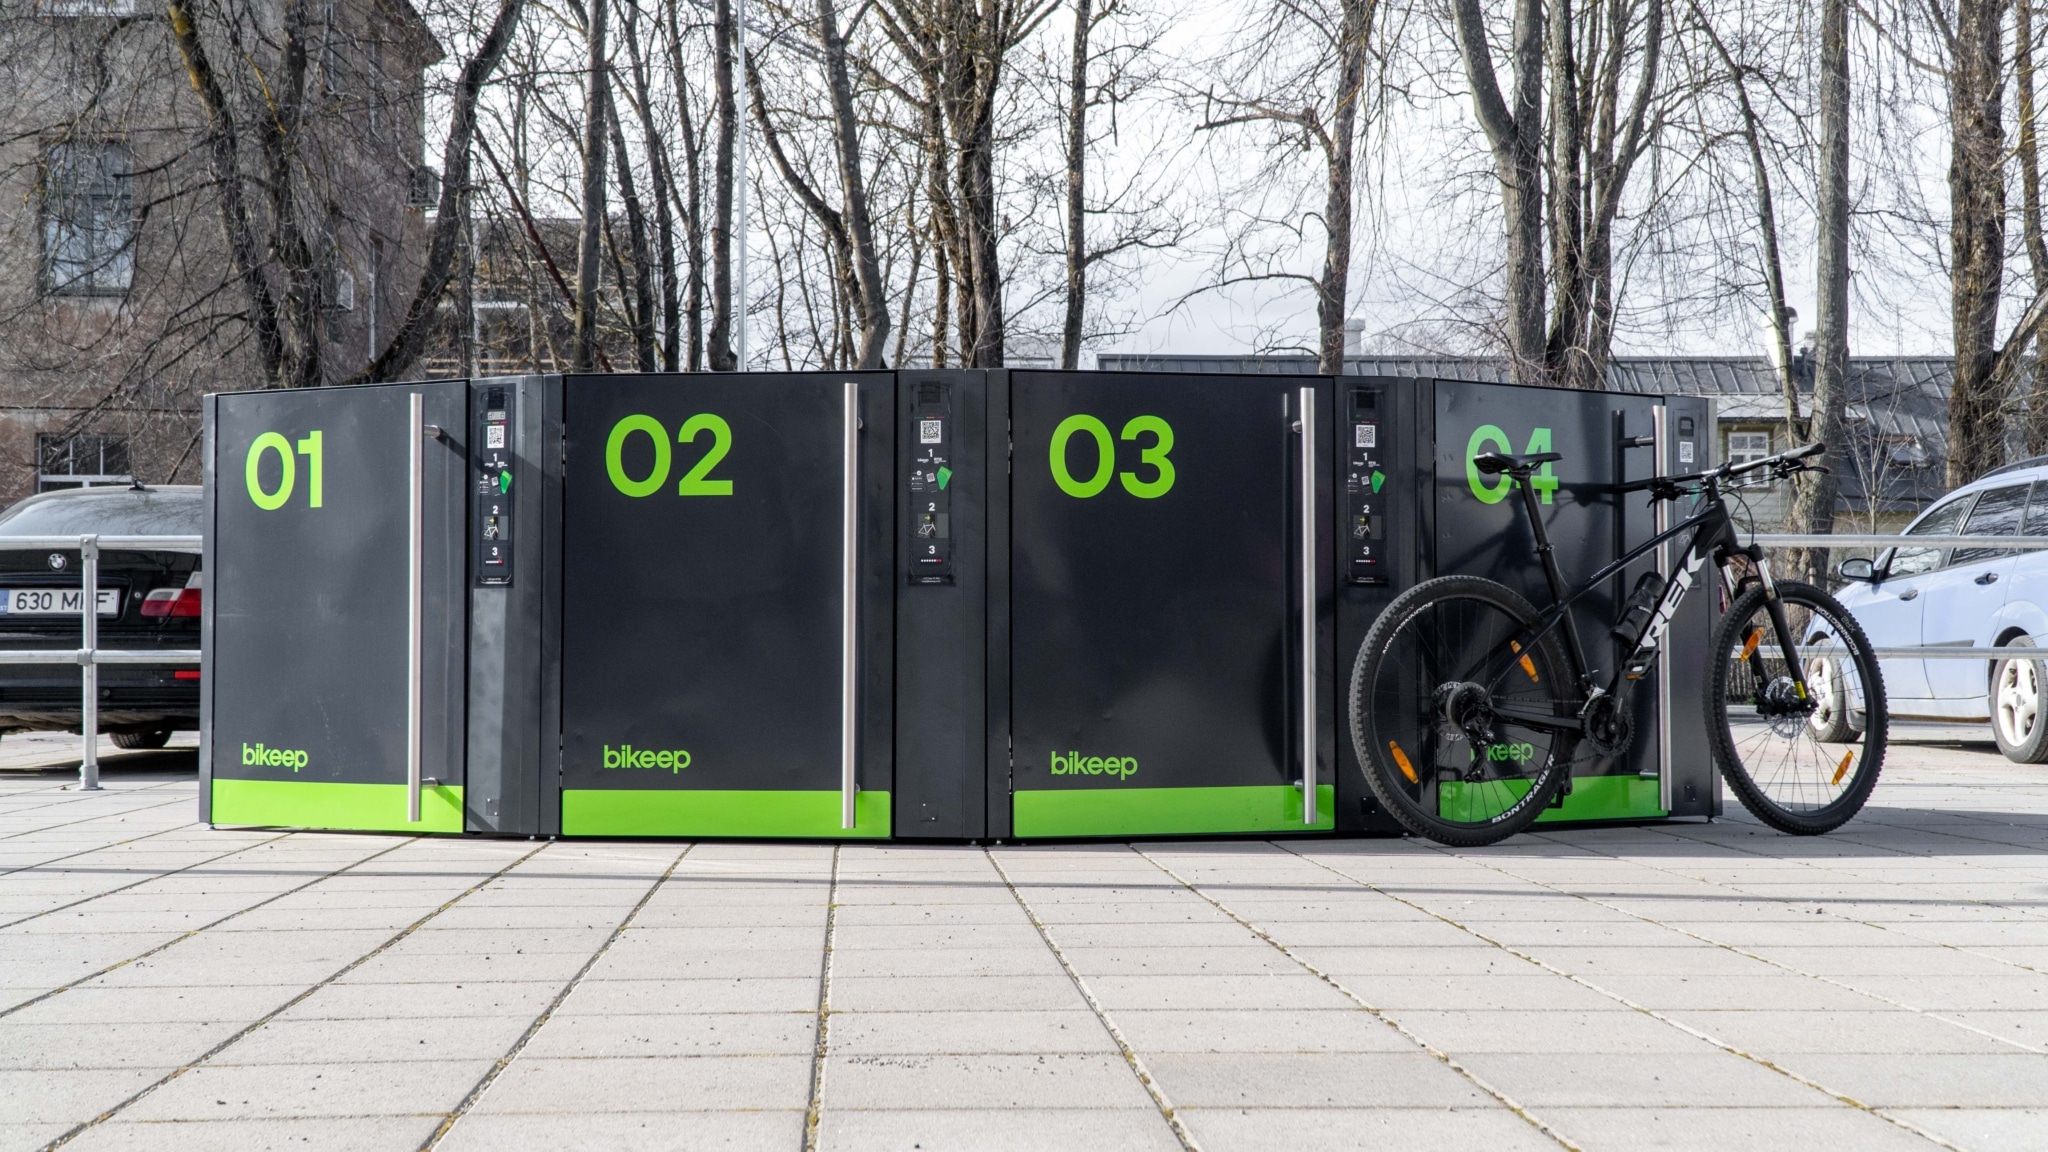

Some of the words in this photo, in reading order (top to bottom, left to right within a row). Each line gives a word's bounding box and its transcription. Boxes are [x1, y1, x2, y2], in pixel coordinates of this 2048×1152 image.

[492, 452, 498, 462] 1
[605, 413, 734, 499] 02
[928, 448, 934, 458] 1
[1049, 414, 1177, 500] 03
[1362, 452, 1368, 461] 1
[246, 430, 323, 510] 01
[1466, 424, 1558, 505] 04
[1684, 466, 1689, 474] 1
[492, 505, 499, 515] 2
[928, 502, 936, 512] 2
[1363, 504, 1370, 514] 2
[491, 546, 499, 557] 3
[928, 545, 936, 555] 3
[1363, 546, 1370, 556] 3
[16, 591, 52, 610] 630
[61, 591, 110, 610] MF
[1633, 545, 1706, 655] REK
[242, 743, 309, 772] bikeep
[603, 745, 692, 774] bikeep
[1471, 742, 1534, 766] keep
[1051, 751, 1138, 780] bikeep
